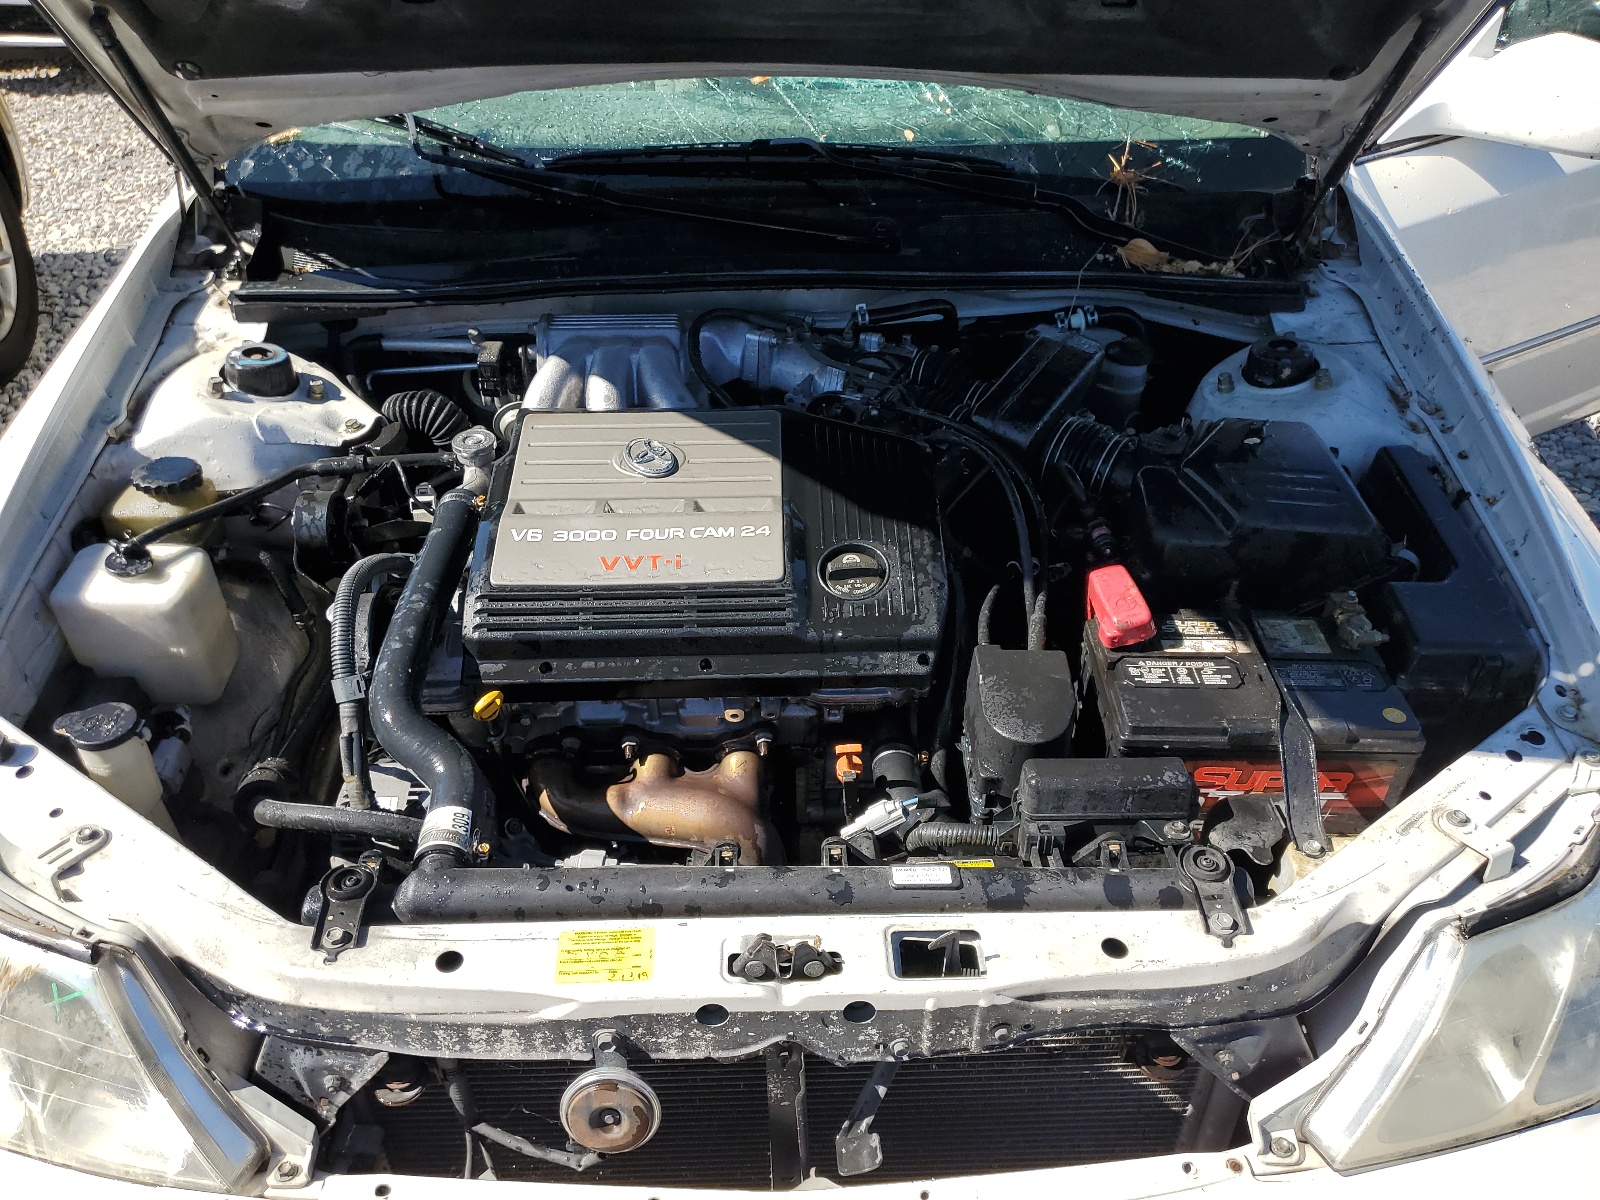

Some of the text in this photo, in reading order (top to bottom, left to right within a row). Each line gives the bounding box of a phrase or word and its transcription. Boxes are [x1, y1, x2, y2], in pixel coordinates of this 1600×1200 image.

[510, 525, 772, 542] V6 3000 FOUR CAM 24
[599, 553, 683, 572] VVT-i
[1161, 625, 1219, 633] START
[1194, 766, 1354, 792] SUPR
[452, 812, 470, 832] 309
